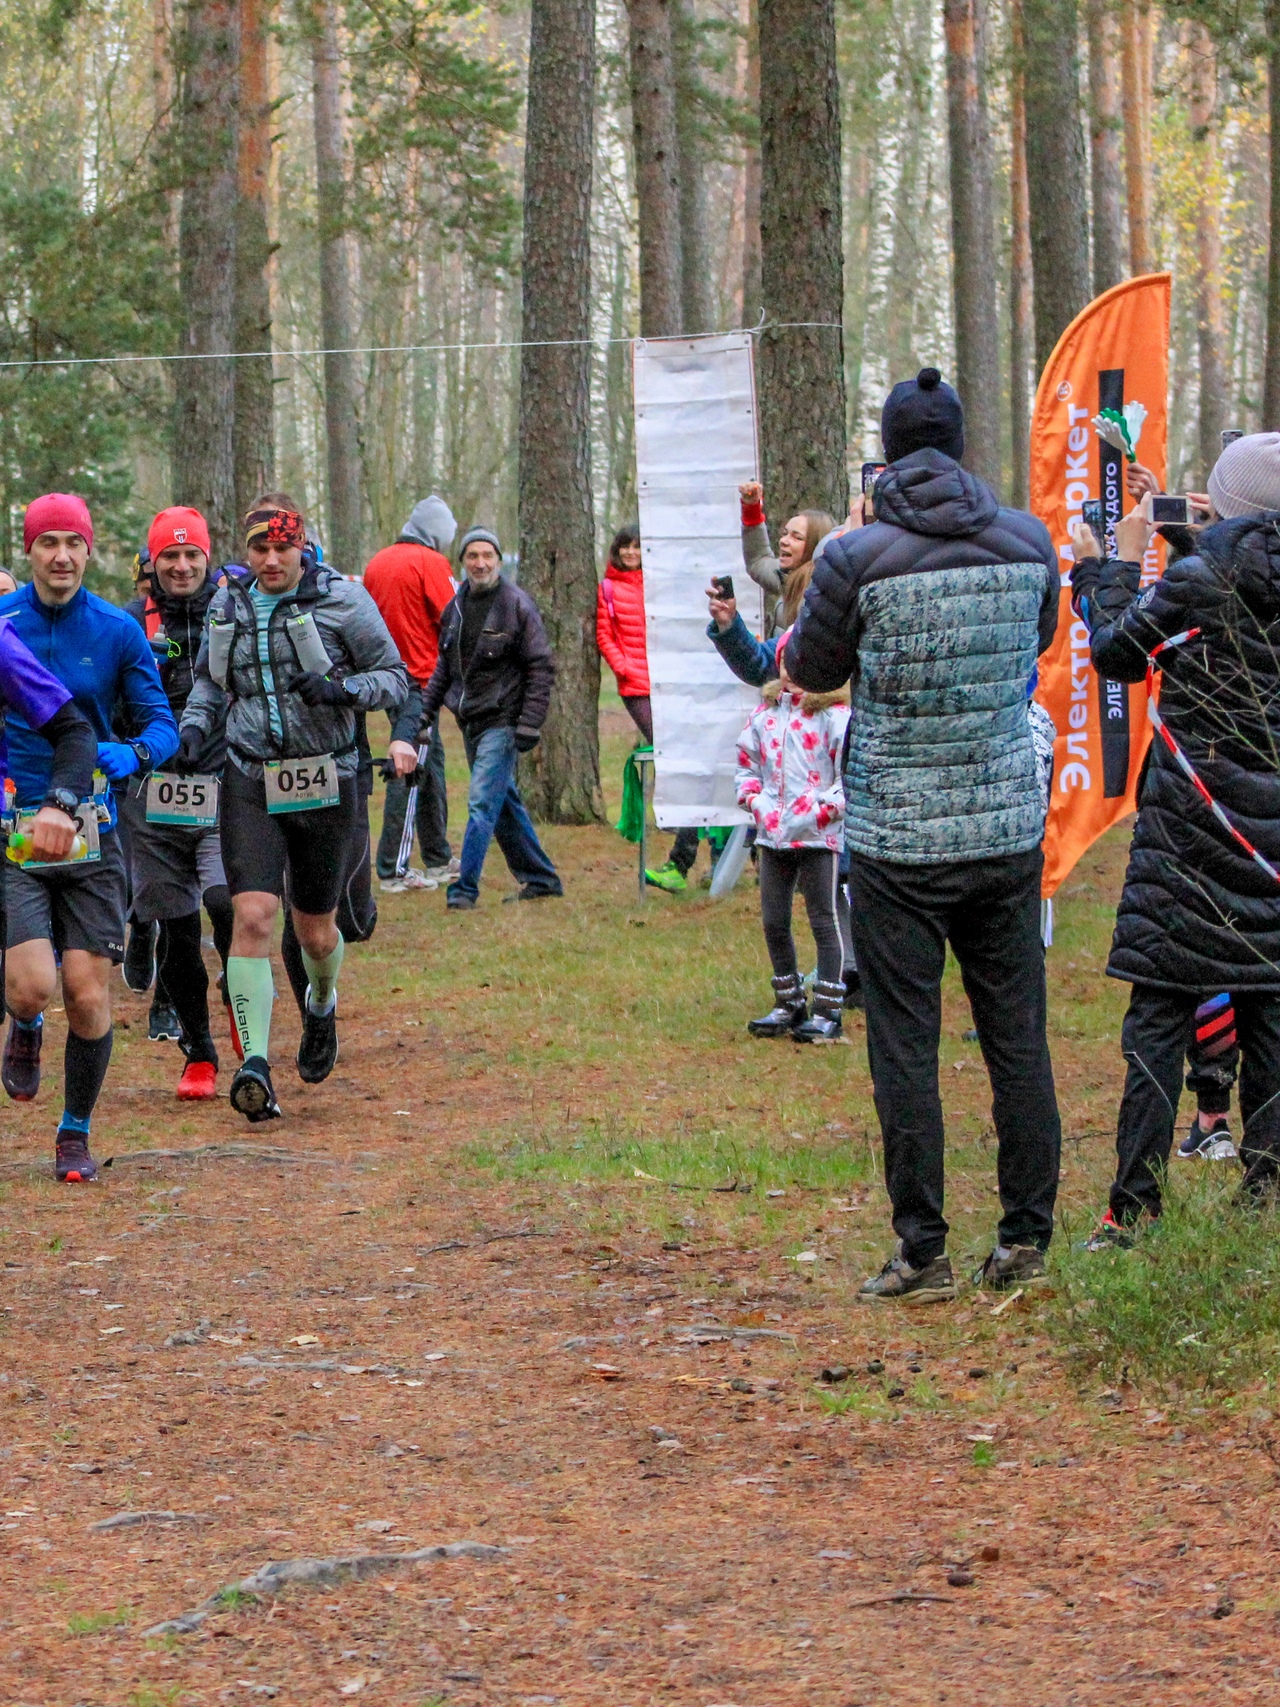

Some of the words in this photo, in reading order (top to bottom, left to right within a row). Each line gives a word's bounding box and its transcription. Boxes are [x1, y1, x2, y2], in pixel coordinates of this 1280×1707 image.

[1059, 403, 1092, 793] Электрркет
[277, 766, 328, 792] 054
[158, 783, 206, 805] 055
